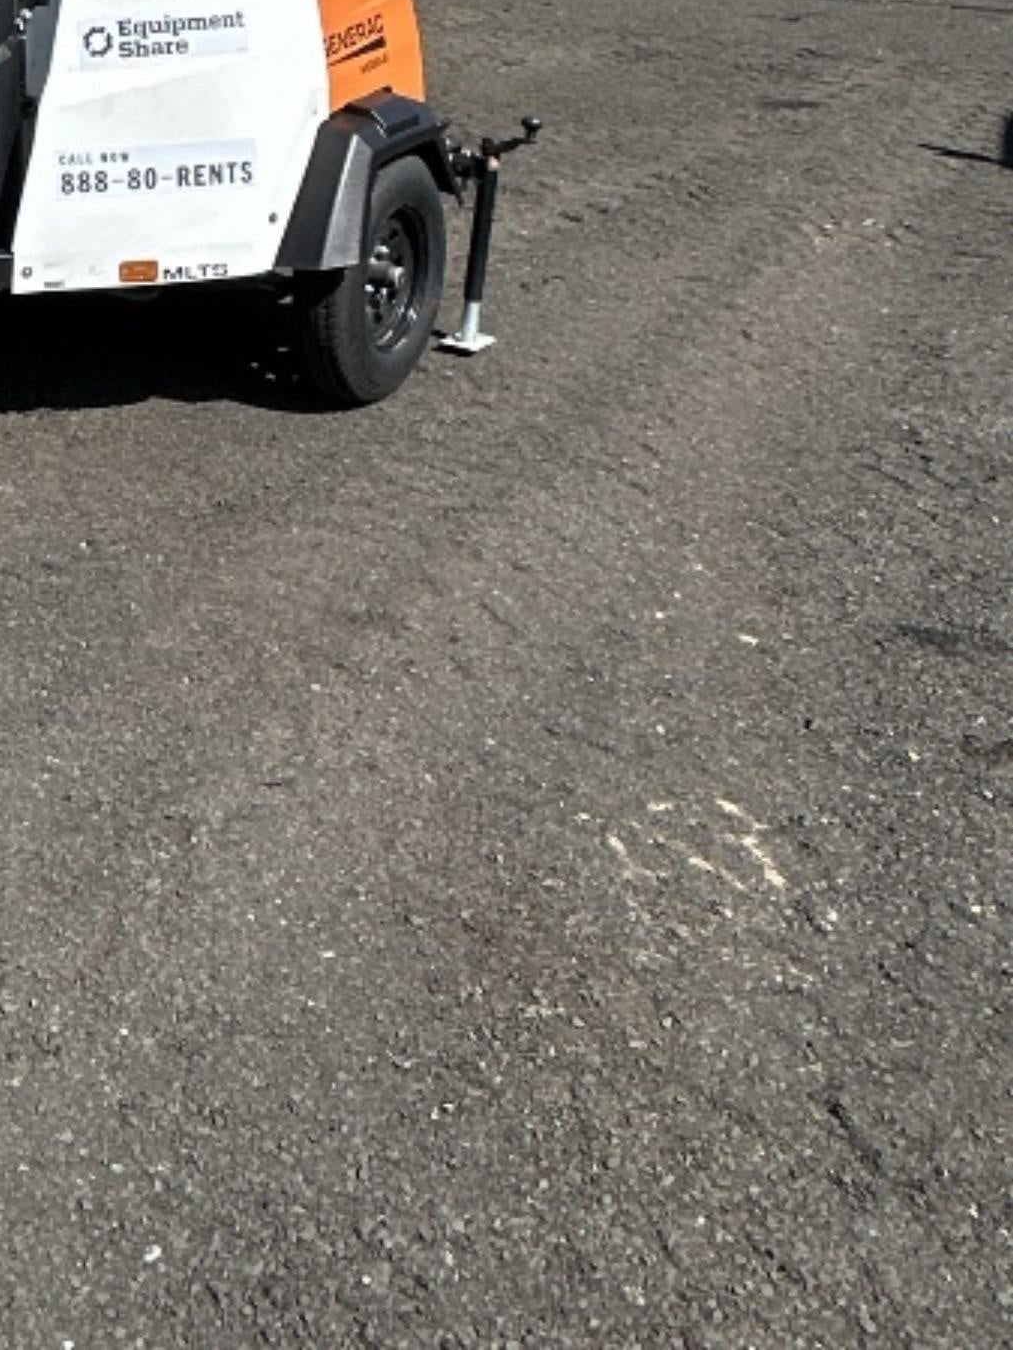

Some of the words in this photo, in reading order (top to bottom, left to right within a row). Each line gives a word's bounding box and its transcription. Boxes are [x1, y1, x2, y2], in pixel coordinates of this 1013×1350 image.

[116, 11, 245, 39] Equipment
[118, 38, 189, 58] Share
[58, 152, 92, 166] CALL
[60, 161, 254, 196] 888-80-RENTS
